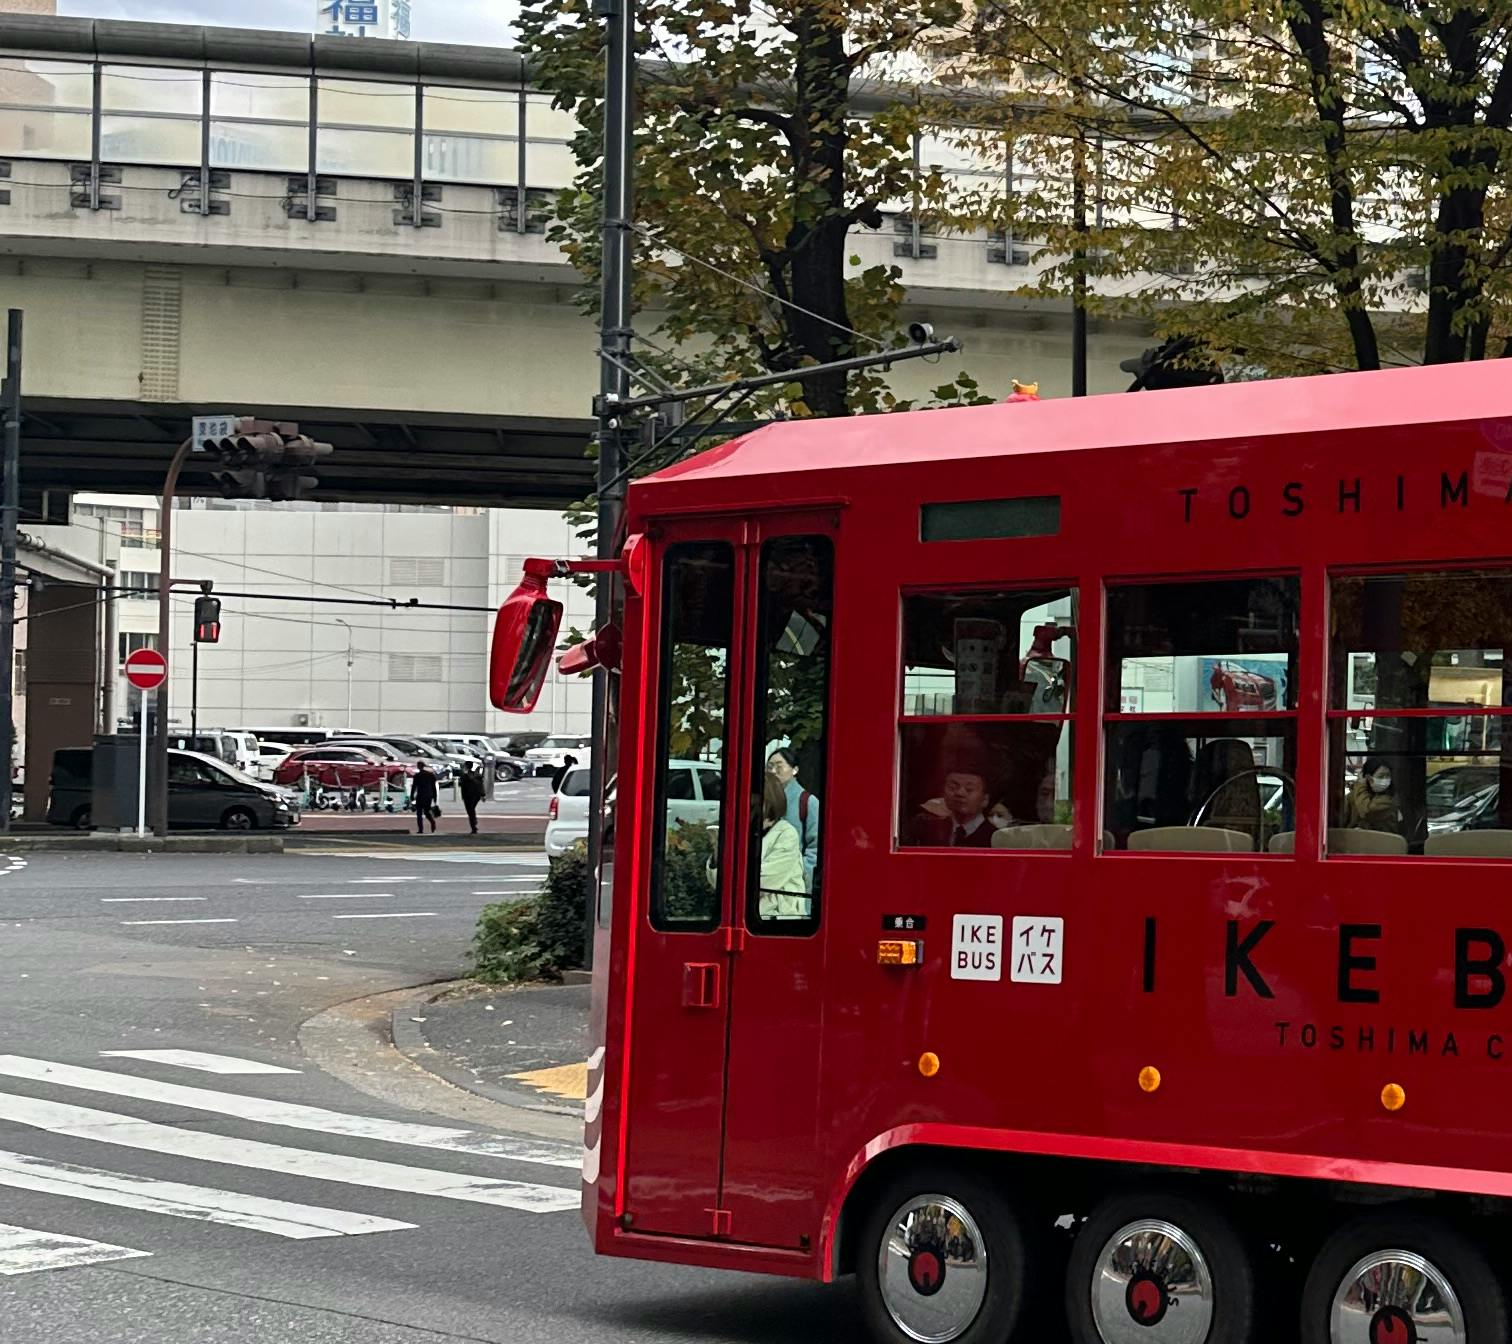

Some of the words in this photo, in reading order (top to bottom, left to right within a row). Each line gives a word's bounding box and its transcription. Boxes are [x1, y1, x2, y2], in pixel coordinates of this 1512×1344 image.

[960, 924, 996, 944] IKE
[1019, 924, 1056, 948] イケ
[957, 951, 996, 970] BUS
[1017, 951, 1056, 976] バス
[1274, 1021, 1460, 1057] TOSHIMA
